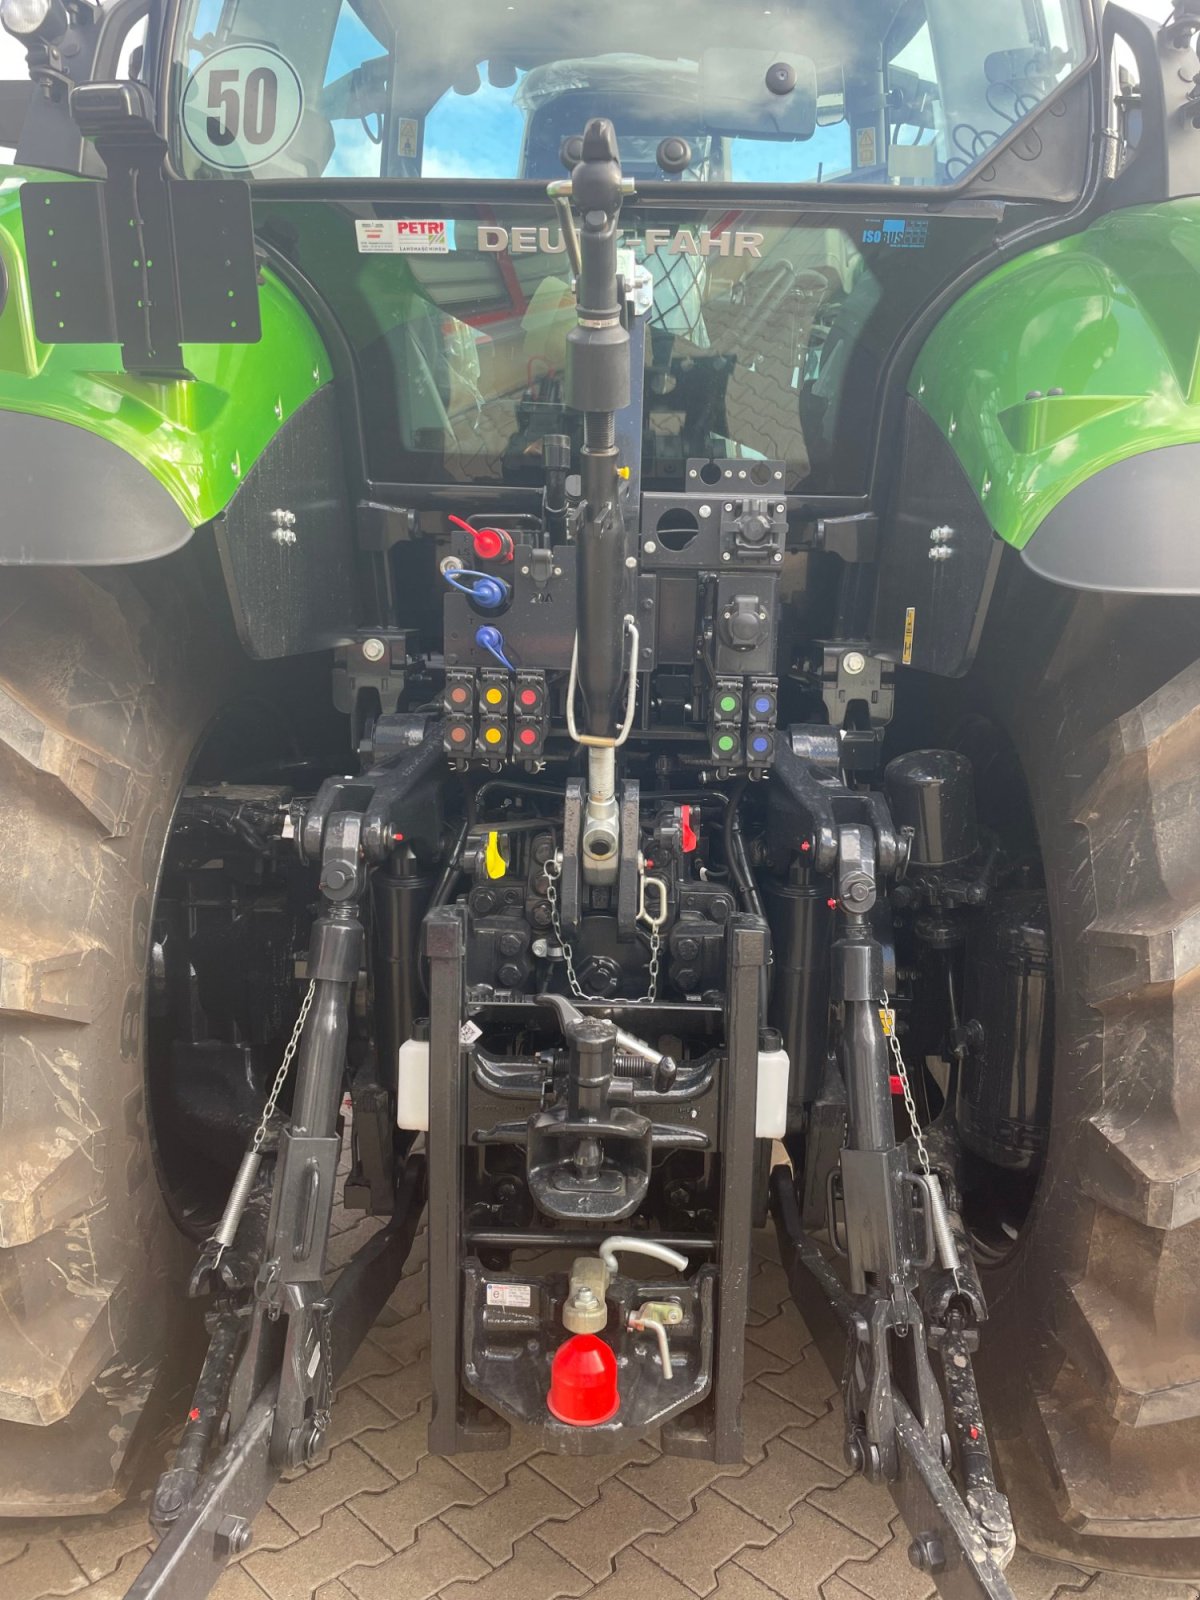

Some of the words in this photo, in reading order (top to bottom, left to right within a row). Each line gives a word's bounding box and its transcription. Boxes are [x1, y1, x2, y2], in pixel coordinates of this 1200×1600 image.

[206, 67, 278, 147] 50
[397, 221, 444, 235] PETRI
[477, 226, 765, 258] DEU-FAHR
